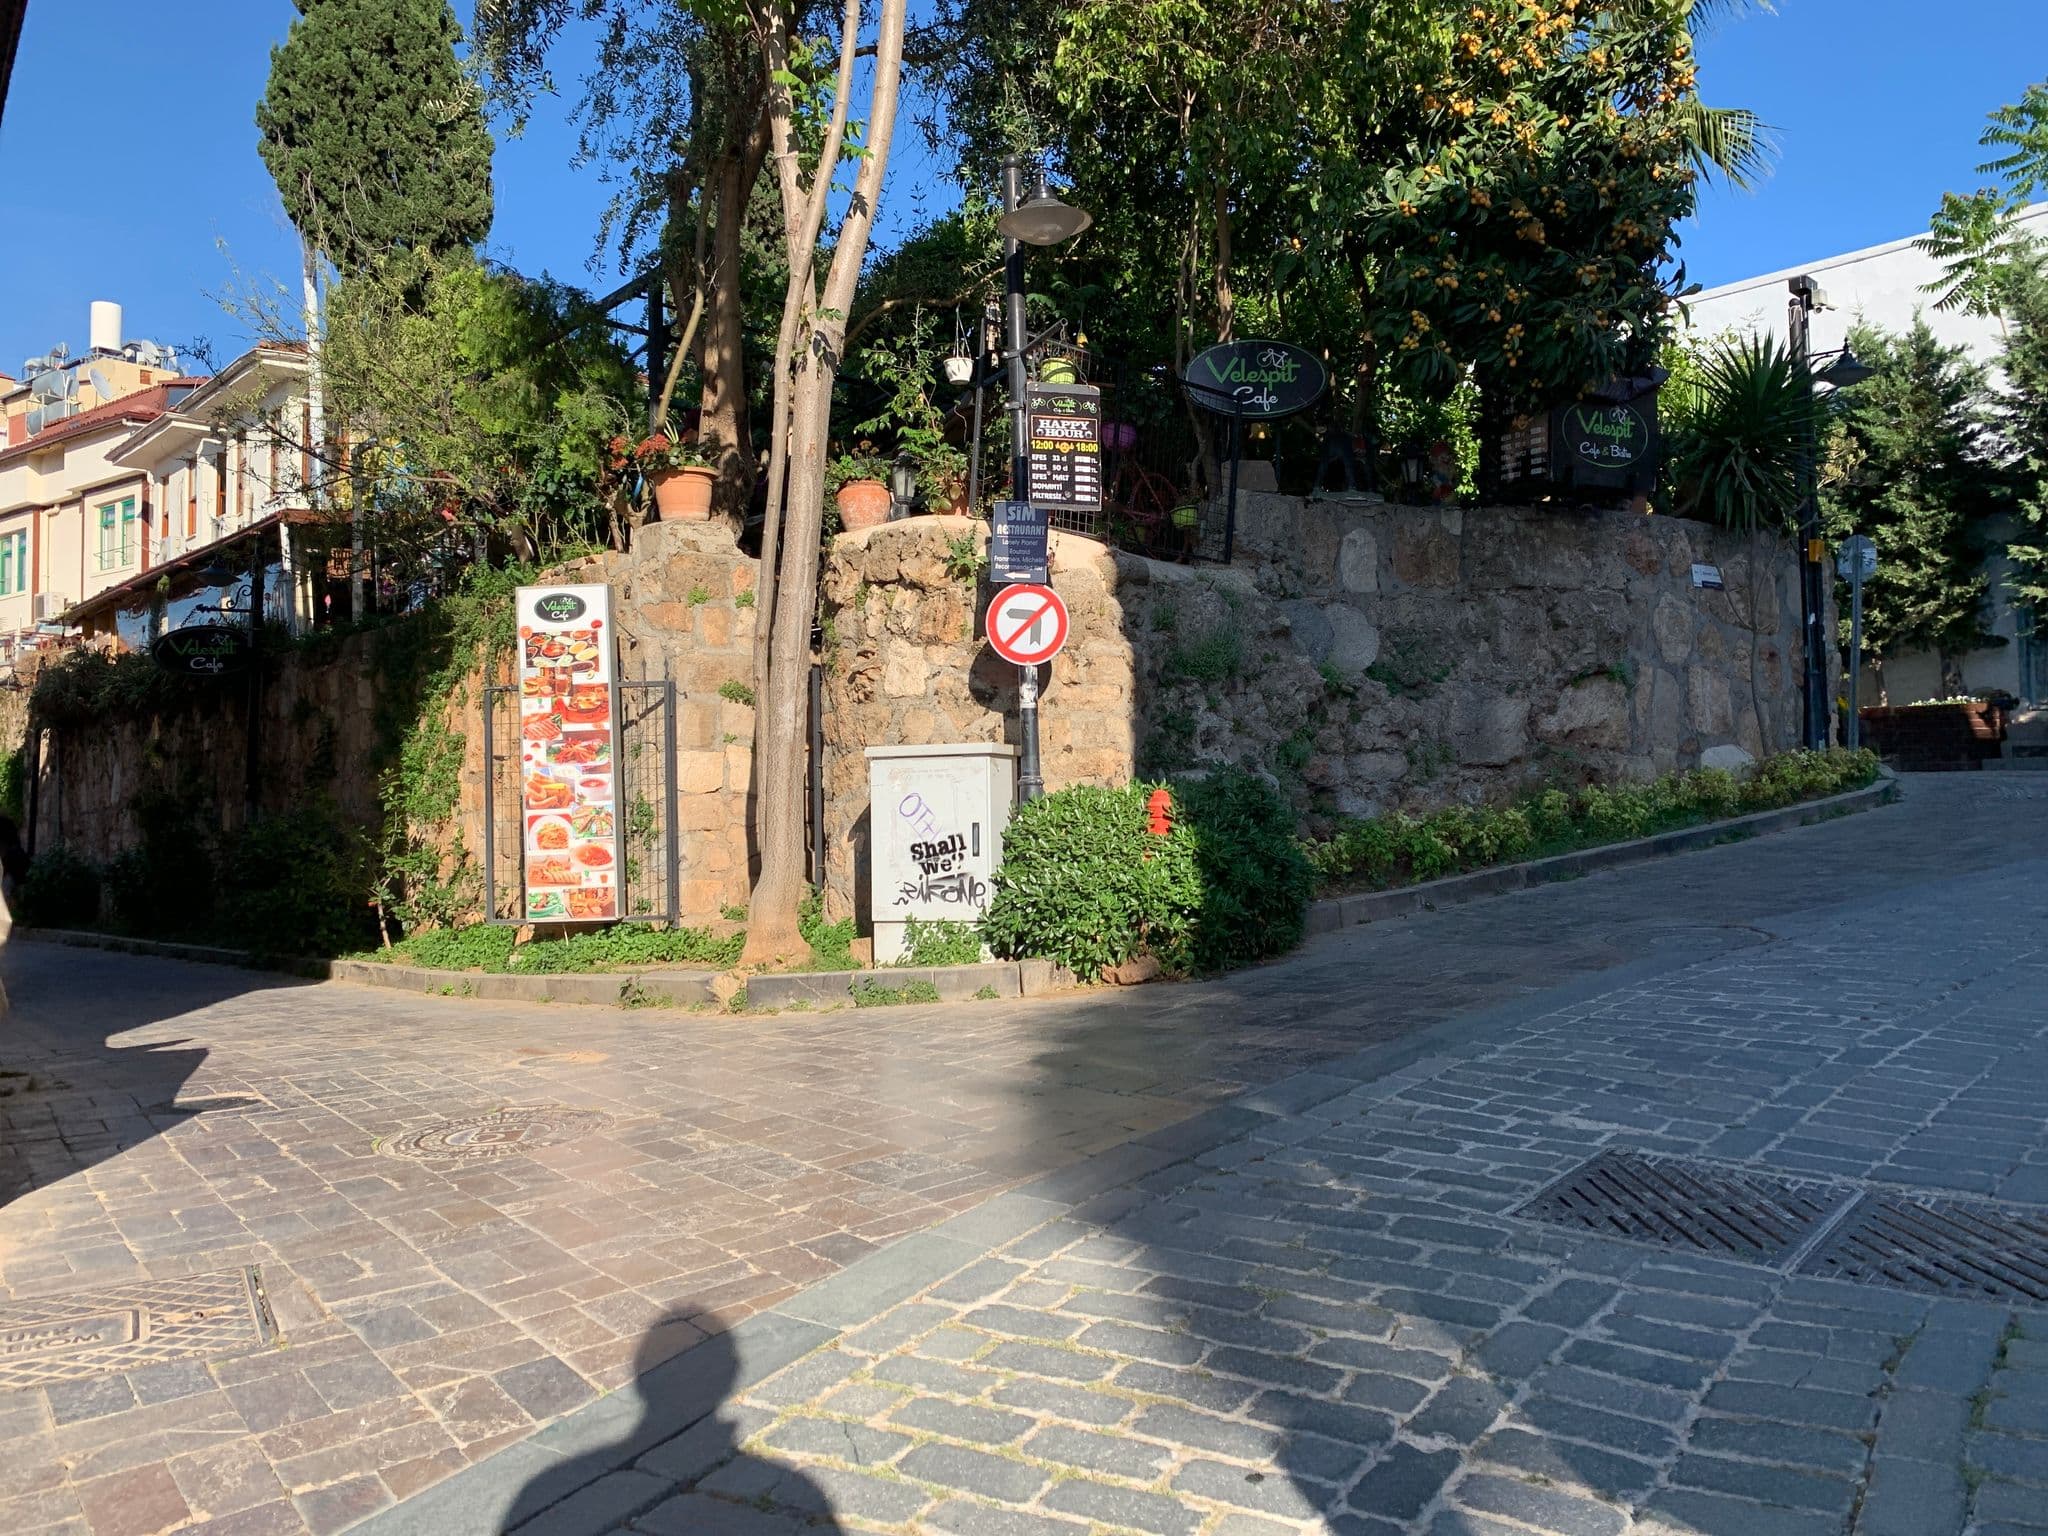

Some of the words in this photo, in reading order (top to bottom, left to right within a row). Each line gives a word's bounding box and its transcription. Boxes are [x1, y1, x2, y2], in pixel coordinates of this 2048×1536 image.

[1205, 356, 1301, 391] Velespit
[1232, 386, 1278, 411] Cafe
[1039, 419, 1090, 430] HAPPY
[1576, 407, 1636, 445] Velespit
[1044, 428, 1084, 438] HOUR
[1031, 440, 1053, 450] 12:00
[1075, 442, 1098, 453] 18:00
[1602, 446, 1609, 456] &
[551, 611, 569, 621] Cafe
[189, 657, 224, 673] Cafe
[910, 832, 967, 861] Shall
